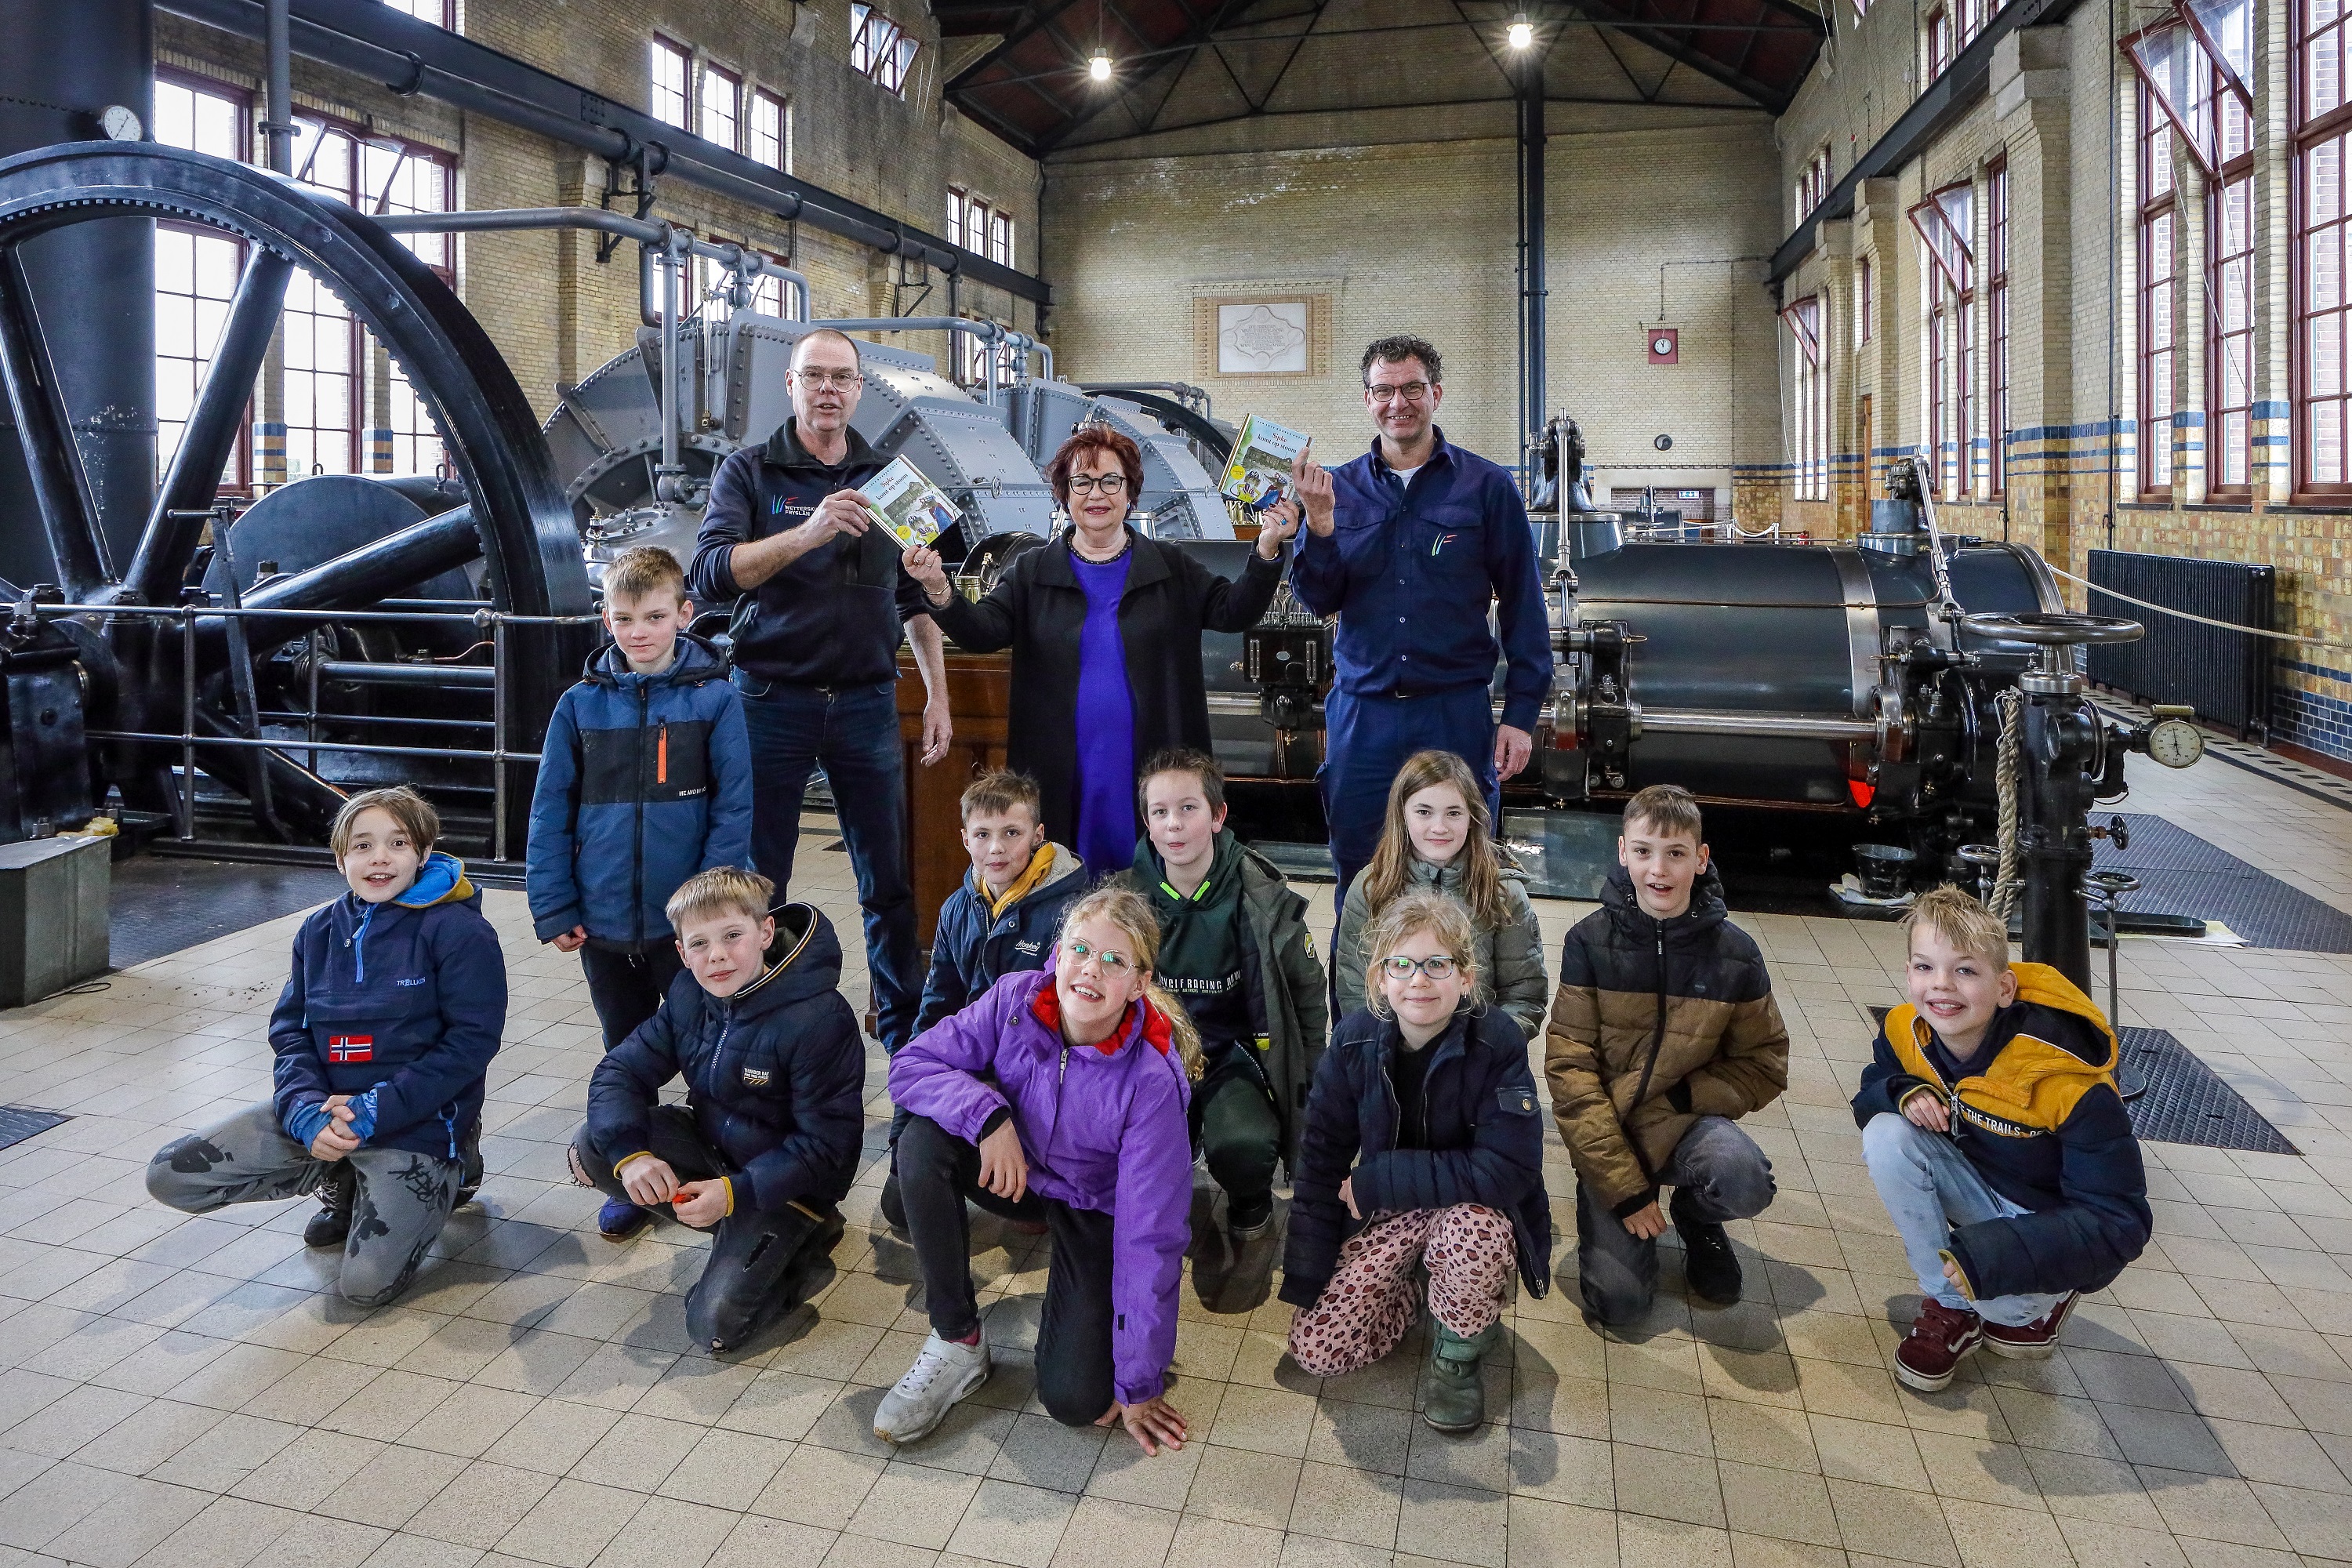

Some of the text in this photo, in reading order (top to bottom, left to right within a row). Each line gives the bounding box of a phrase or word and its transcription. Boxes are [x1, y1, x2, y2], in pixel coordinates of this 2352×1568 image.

[1258, 434, 1272, 444] komt
[1280, 444, 1297, 454] stoom
[1272, 433, 1287, 442] Sipke
[875, 489, 889, 501] komt
[895, 474, 909, 485] stoom
[880, 477, 894, 488] Sipke
[1187, 978, 1222, 989] RACING
[1966, 1108, 1984, 1126] THE
[1985, 1117, 2021, 1137] TRAILS
